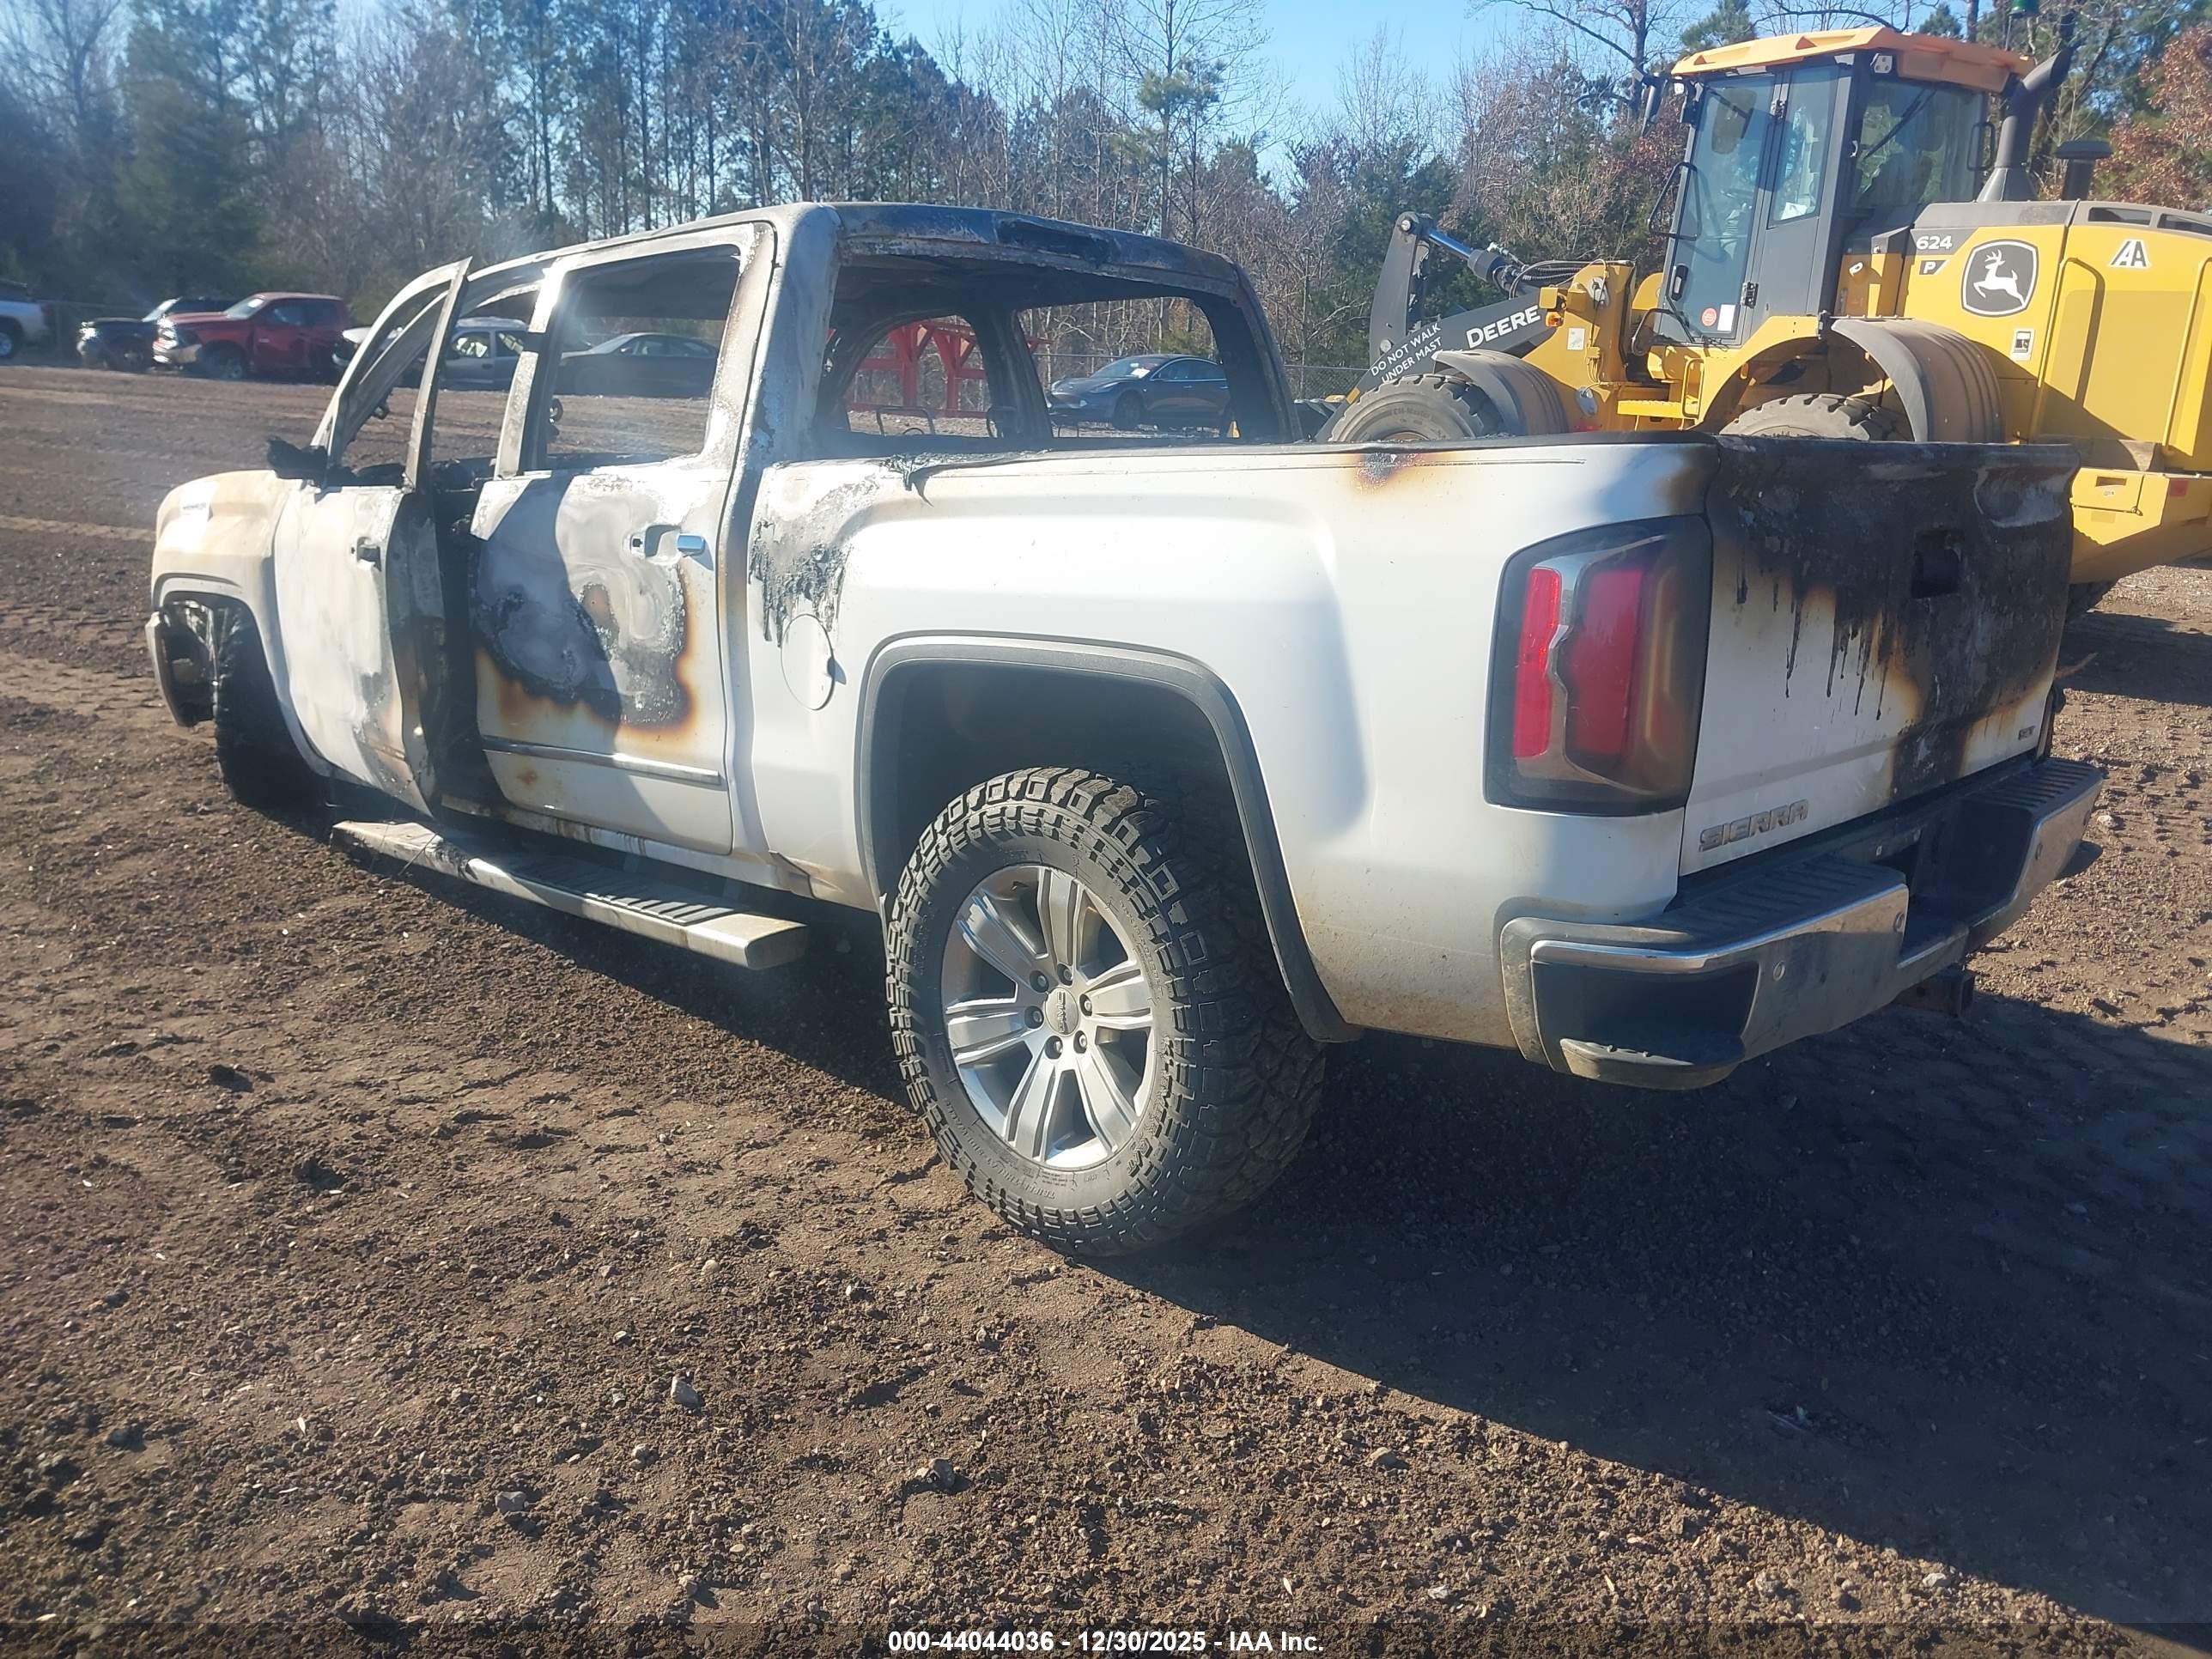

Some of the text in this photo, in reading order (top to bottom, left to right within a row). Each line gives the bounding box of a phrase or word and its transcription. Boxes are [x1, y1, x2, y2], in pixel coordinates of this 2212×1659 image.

[1916, 235, 1953, 250] 624
[1923, 261, 1936, 274] P
[1370, 322, 1442, 376] DO NOT WALK
[1466, 305, 1541, 349] DEERE
[1382, 337, 1442, 383] UNDER MAST
[1698, 799, 1809, 852] SIERRA
[1057, 990, 1066, 1033] GMC
